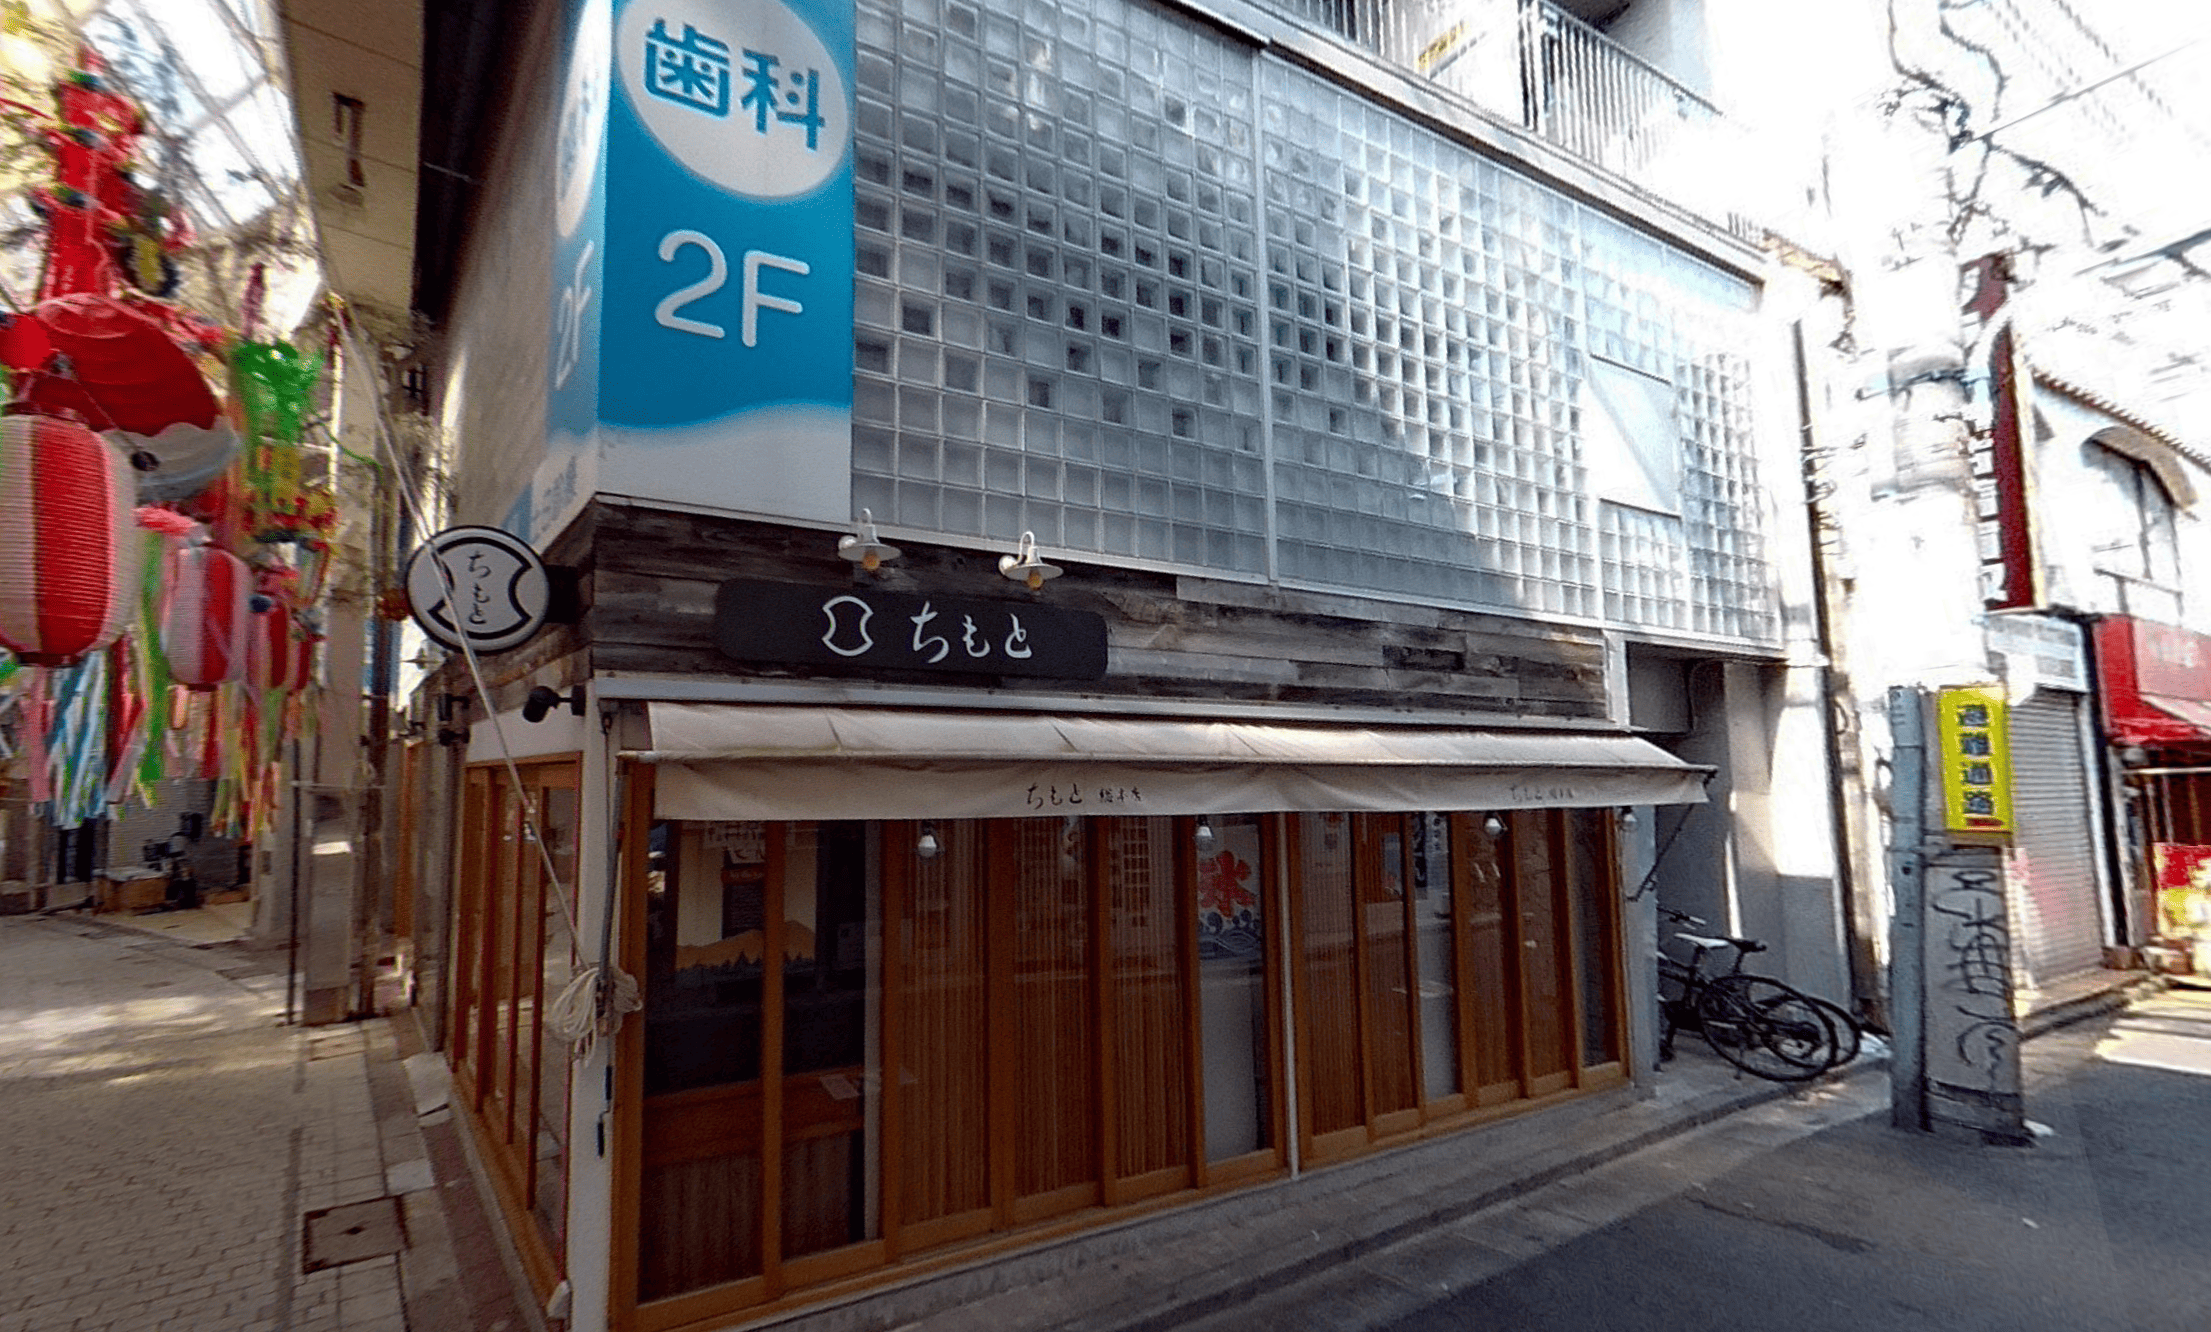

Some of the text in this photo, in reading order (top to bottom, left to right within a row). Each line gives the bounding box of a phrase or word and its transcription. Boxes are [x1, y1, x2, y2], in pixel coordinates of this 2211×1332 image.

[645, 18, 826, 152] 歯科
[654, 229, 811, 348] 2F
[468, 550, 492, 625] ちもと
[910, 600, 1033, 664] ちもと
[1027, 782, 1082, 810] ちもと
